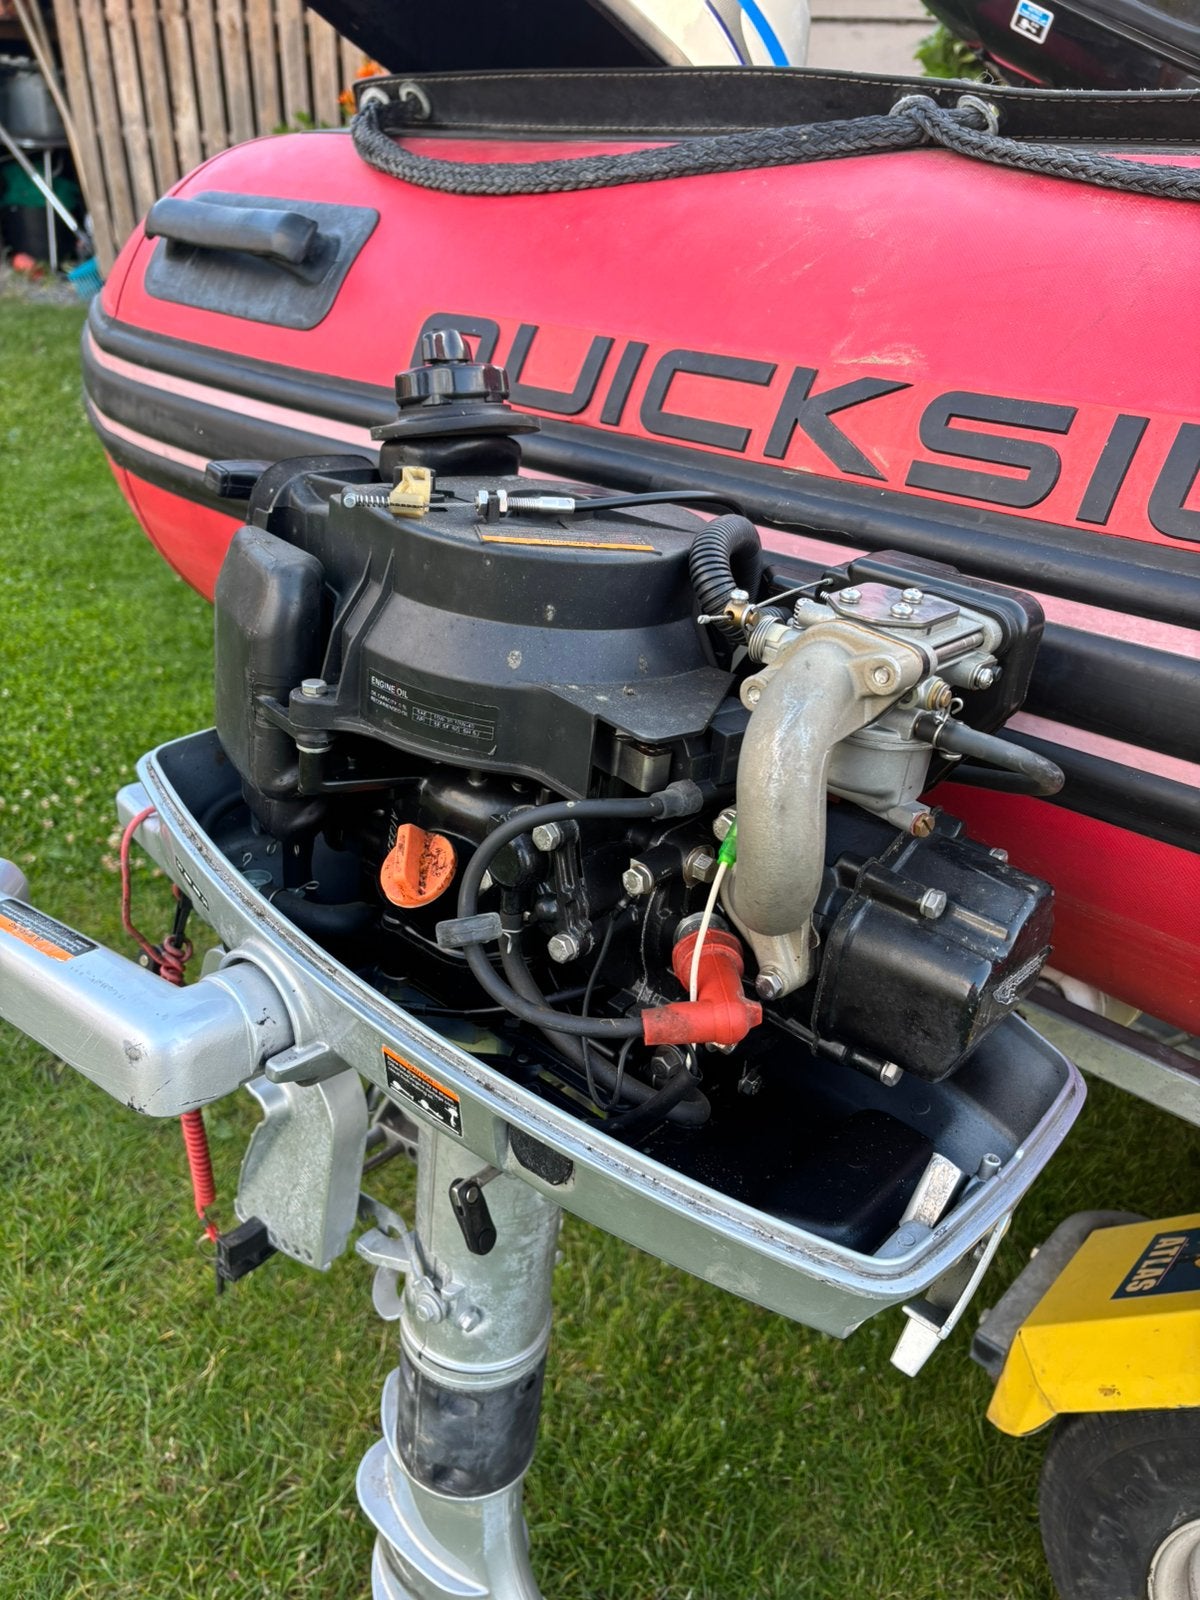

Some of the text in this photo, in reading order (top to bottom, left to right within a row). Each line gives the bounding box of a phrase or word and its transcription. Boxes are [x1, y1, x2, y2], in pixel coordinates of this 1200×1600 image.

[371, 676, 408, 699] ENGINE OIL
[1125, 1236, 1187, 1293] ATLAS
